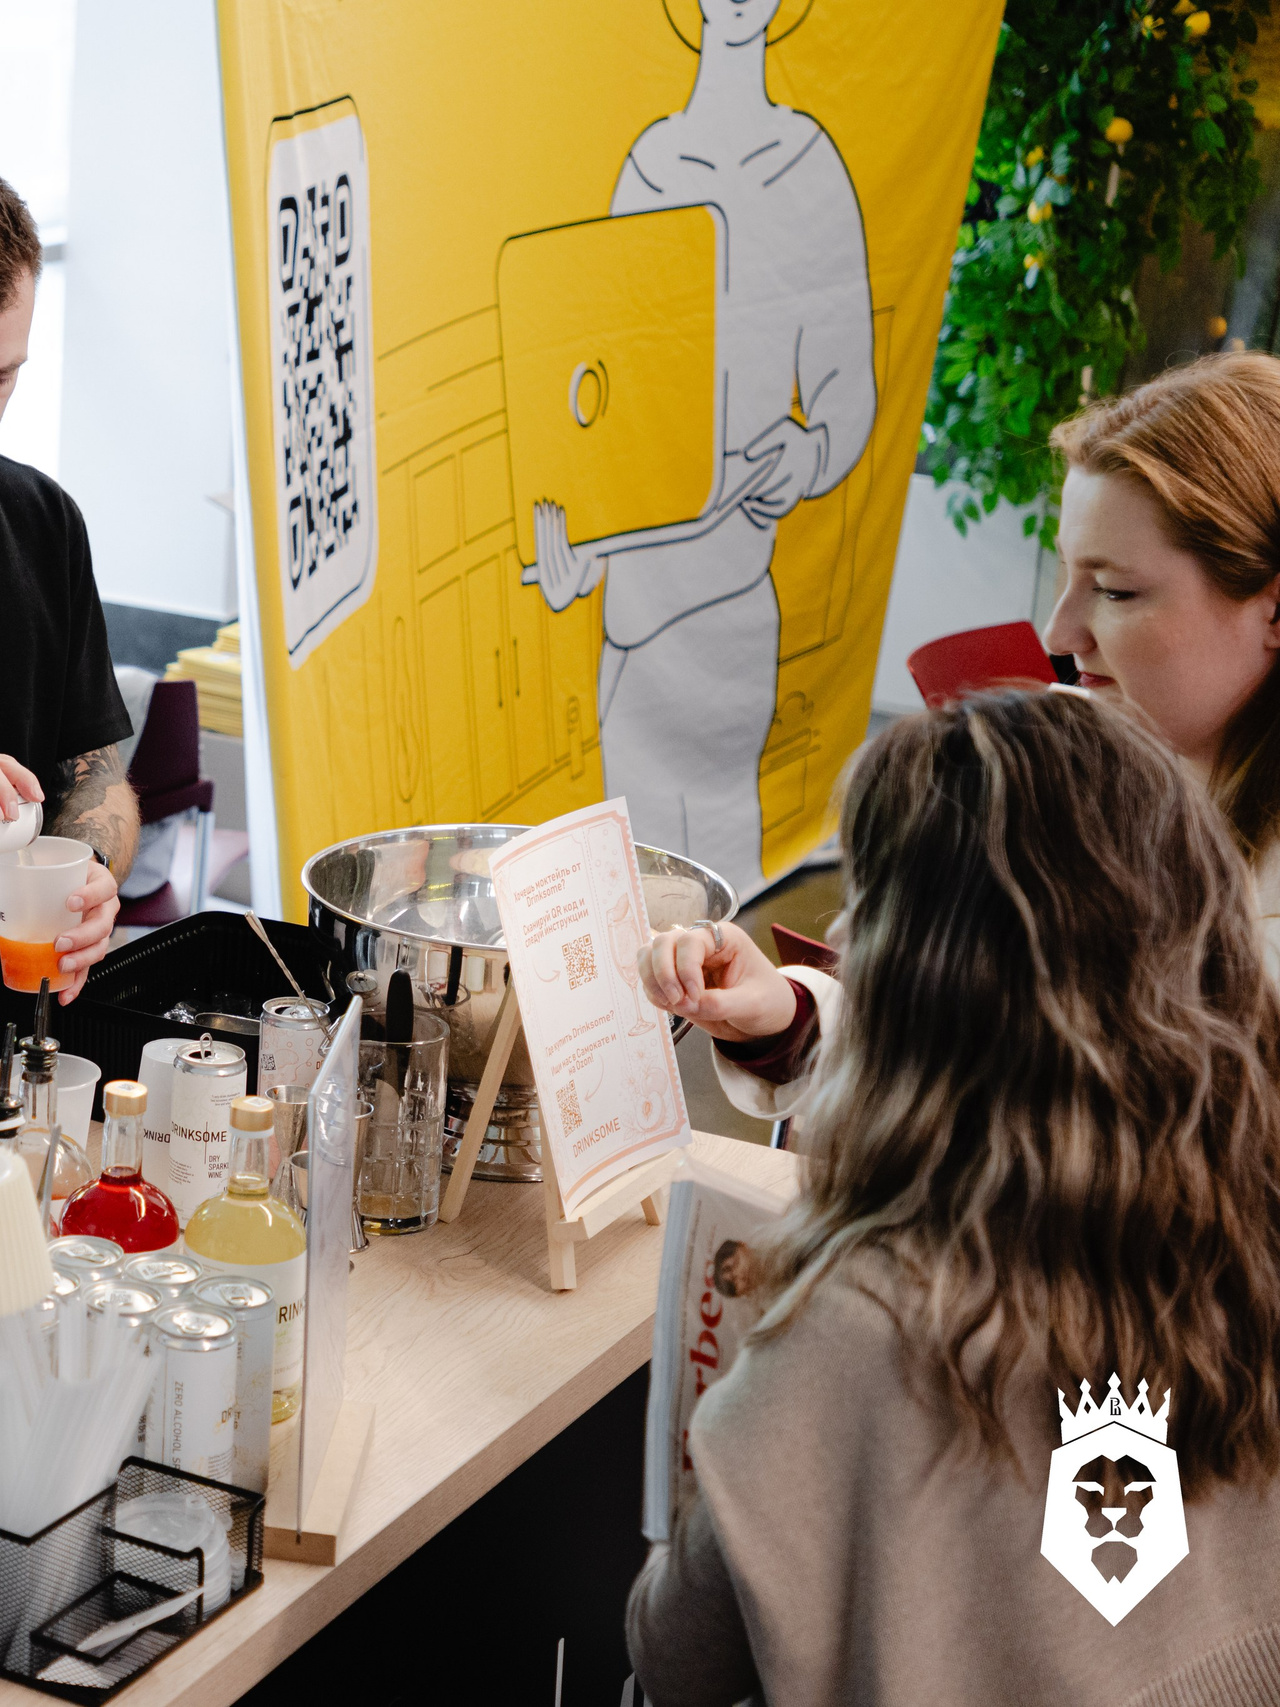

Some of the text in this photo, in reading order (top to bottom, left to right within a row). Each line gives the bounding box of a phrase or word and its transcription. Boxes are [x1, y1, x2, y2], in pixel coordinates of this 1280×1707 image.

[514, 861, 582, 903] Хочешь моктейль от
[526, 881, 566, 908] Drinksome?
[523, 898, 585, 936] Сканируй QR код и
[544, 910, 589, 936] инструкции
[572, 1010, 615, 1040] Drinksome?
[576, 1037, 610, 1060] Самокате
[610, 1033, 617, 1042] и
[576, 1054, 594, 1072] Ozon!
[572, 1117, 621, 1158] DRINKSOME
[208, 1155, 221, 1163] DRY
[208, 1171, 222, 1179] WINE
[174, 1381, 184, 1406] ZERO
[172, 1409, 183, 1455] ALCOHOL
